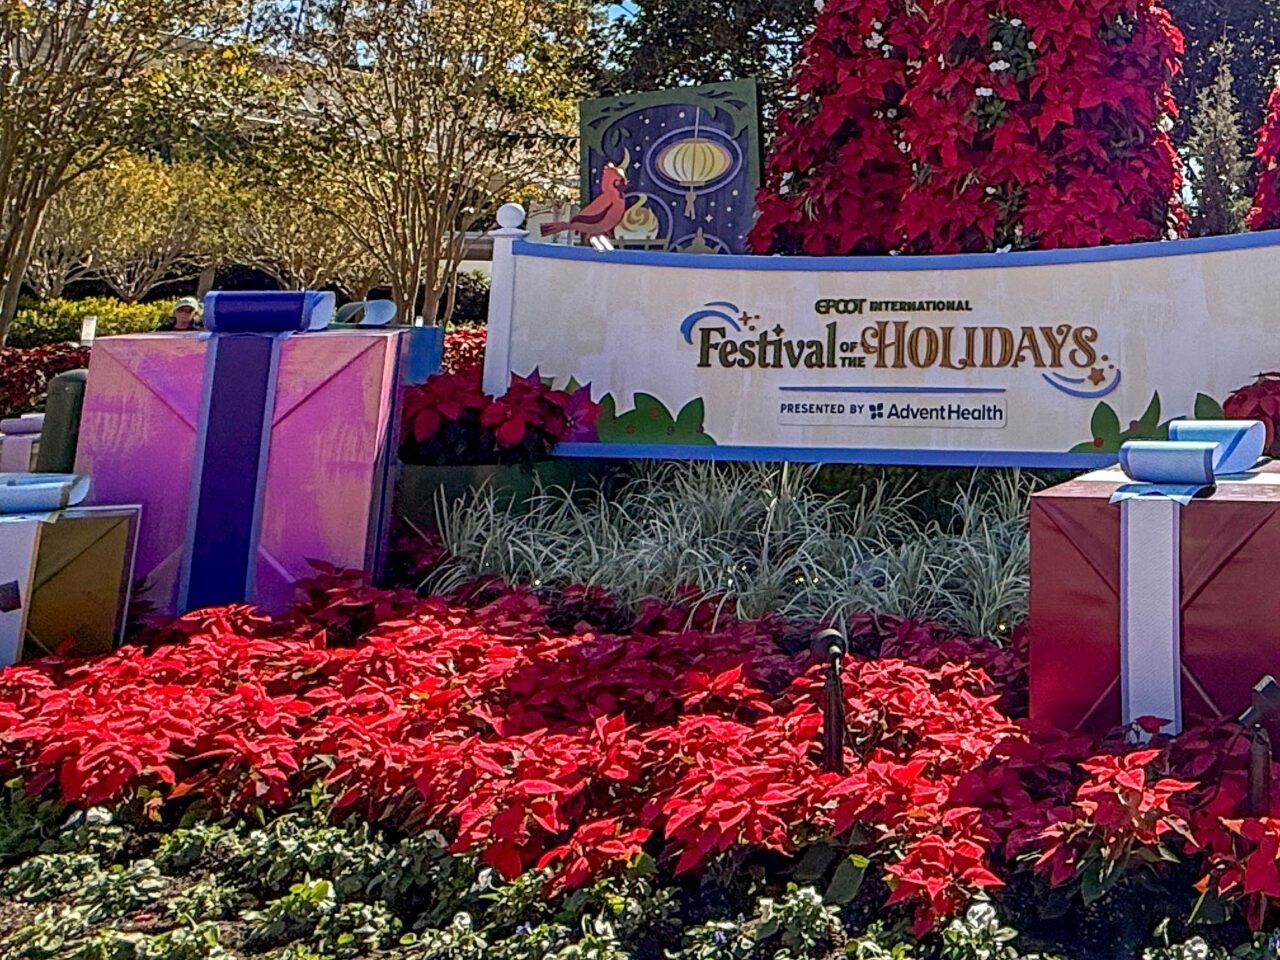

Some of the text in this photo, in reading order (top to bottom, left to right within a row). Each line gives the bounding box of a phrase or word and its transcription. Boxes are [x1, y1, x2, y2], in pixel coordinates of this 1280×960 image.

[814, 298, 972, 315] EPCOT INTERNATIONAL
[696, 320, 1099, 370] Festival OF THE HOLIDAYS
[780, 403, 1003, 422] PRESENTED BY AdventHealth
